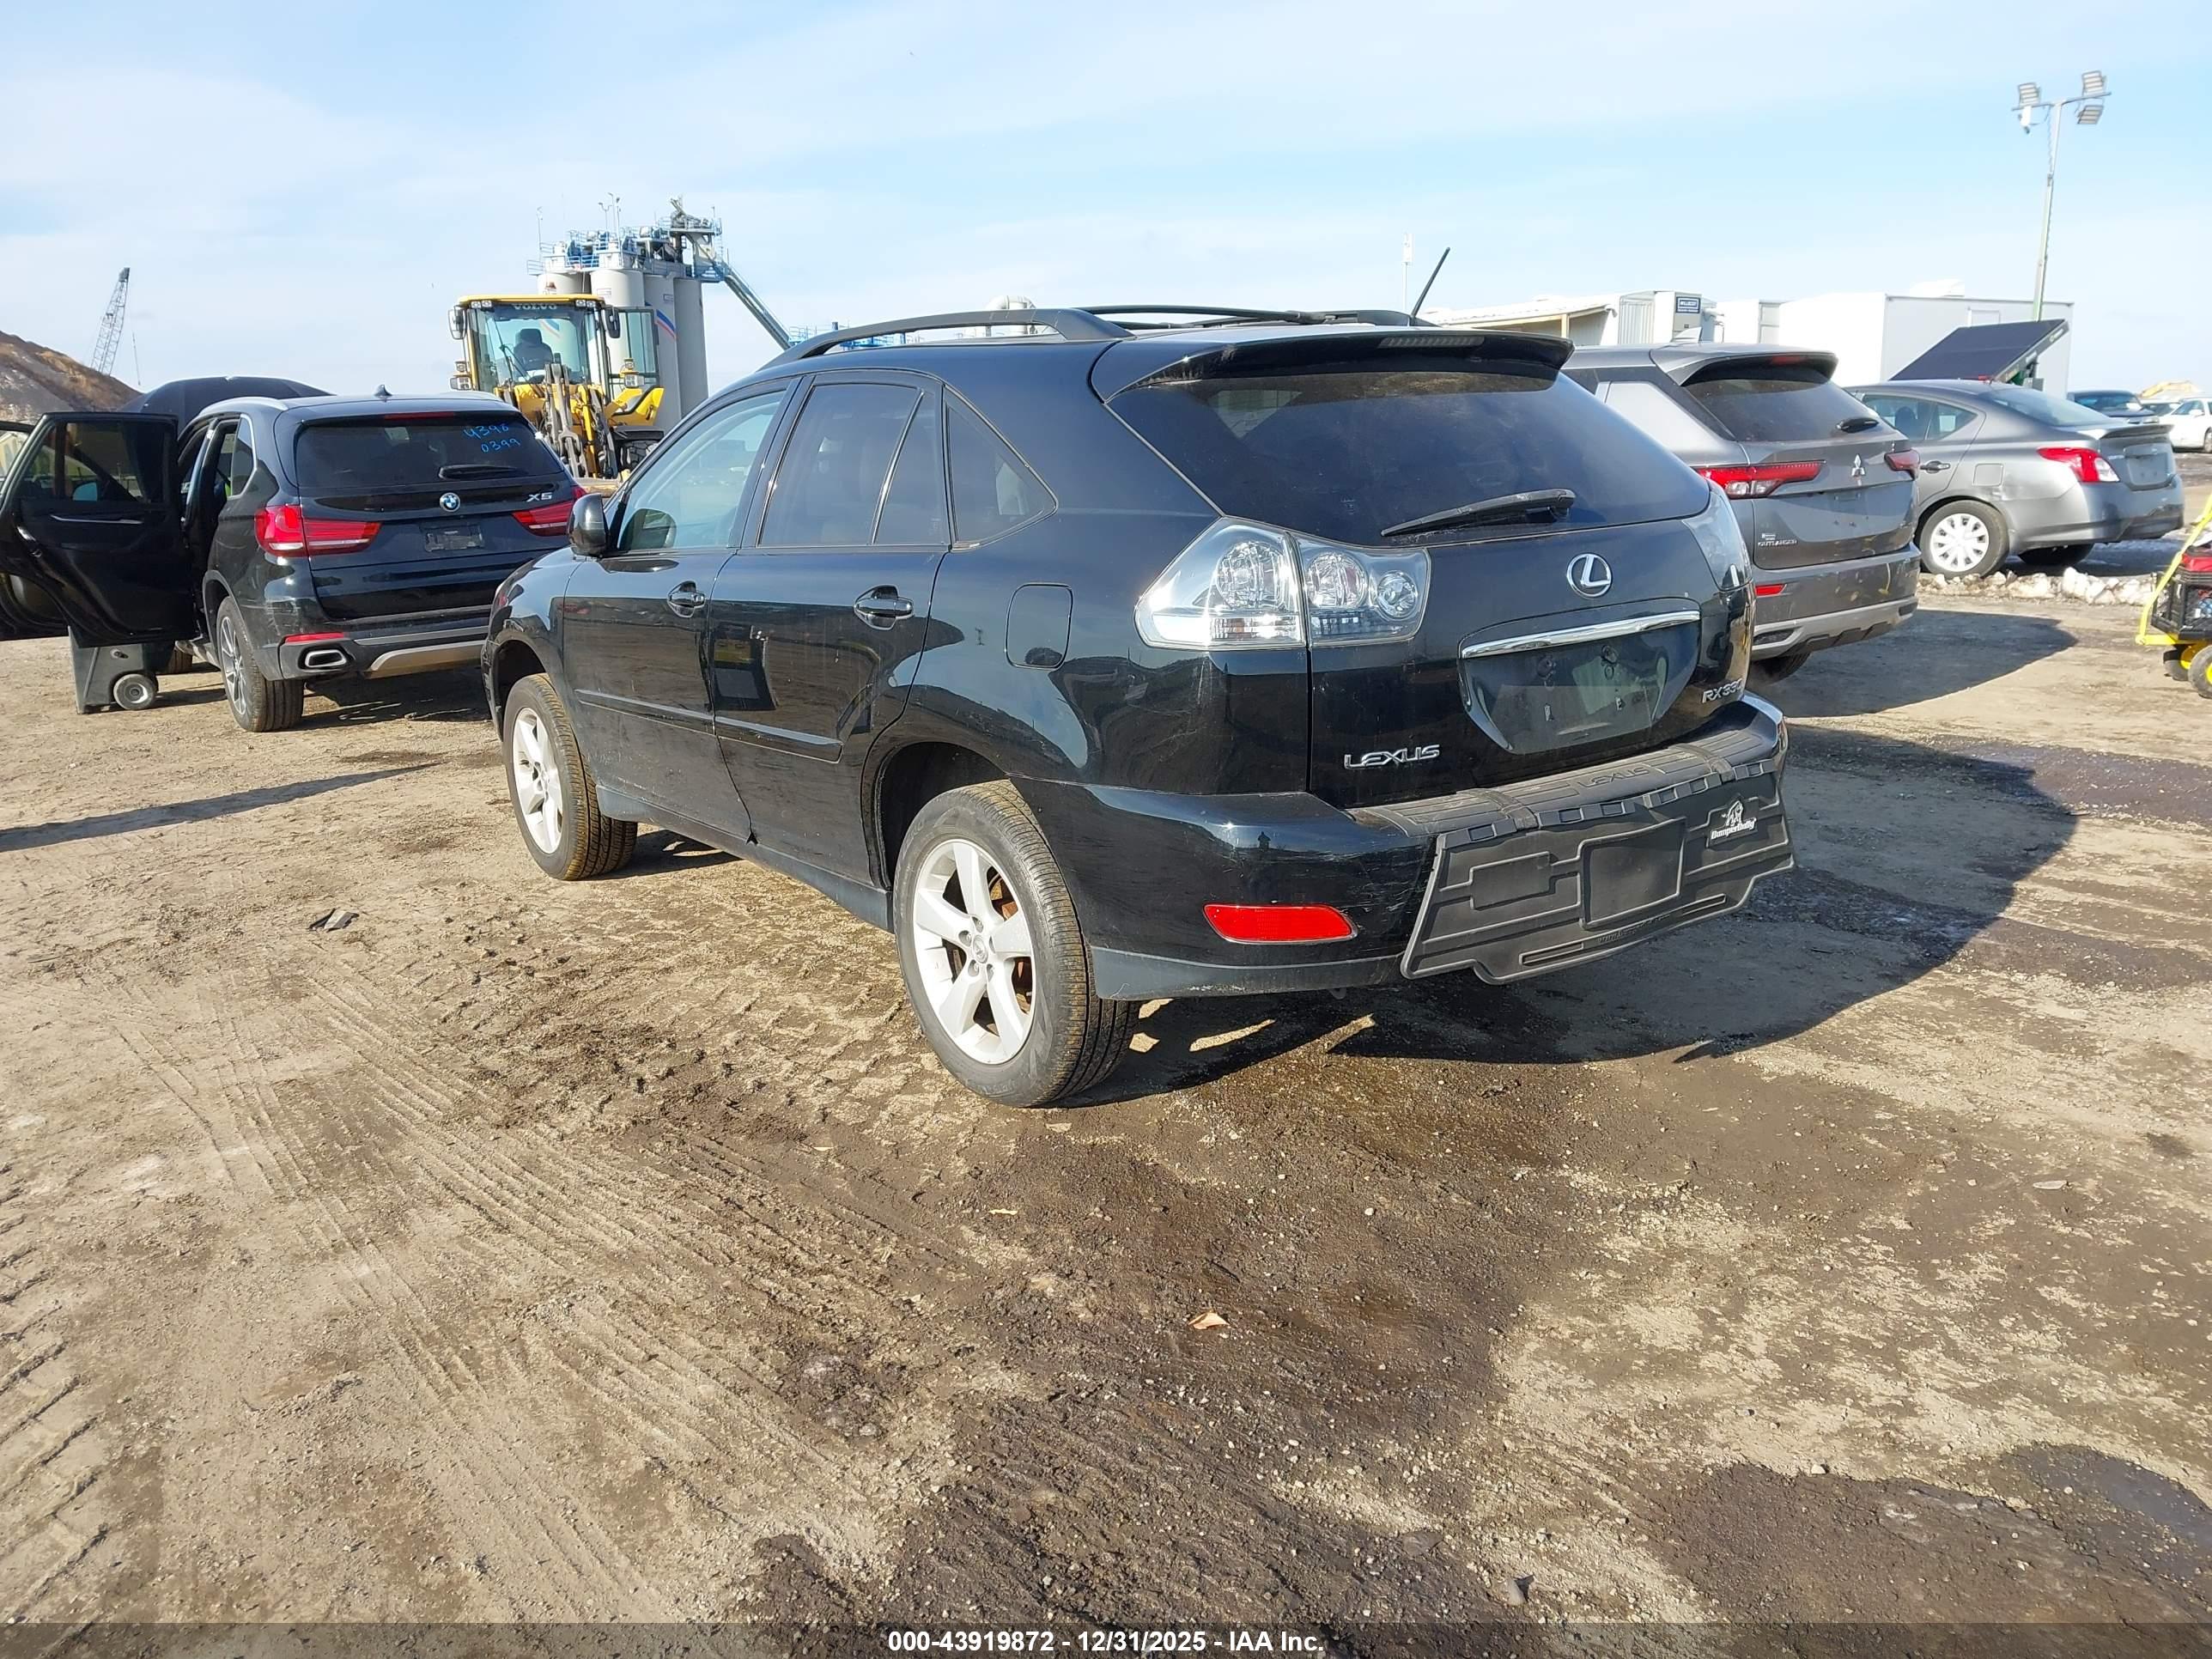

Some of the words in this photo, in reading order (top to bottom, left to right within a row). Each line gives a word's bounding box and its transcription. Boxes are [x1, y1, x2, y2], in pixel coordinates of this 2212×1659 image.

[481, 438, 520, 453] 0399
[526, 492, 553, 502] X5
[1344, 744, 1440, 769] LEXUS
[1577, 766, 1650, 788] LEXUS
